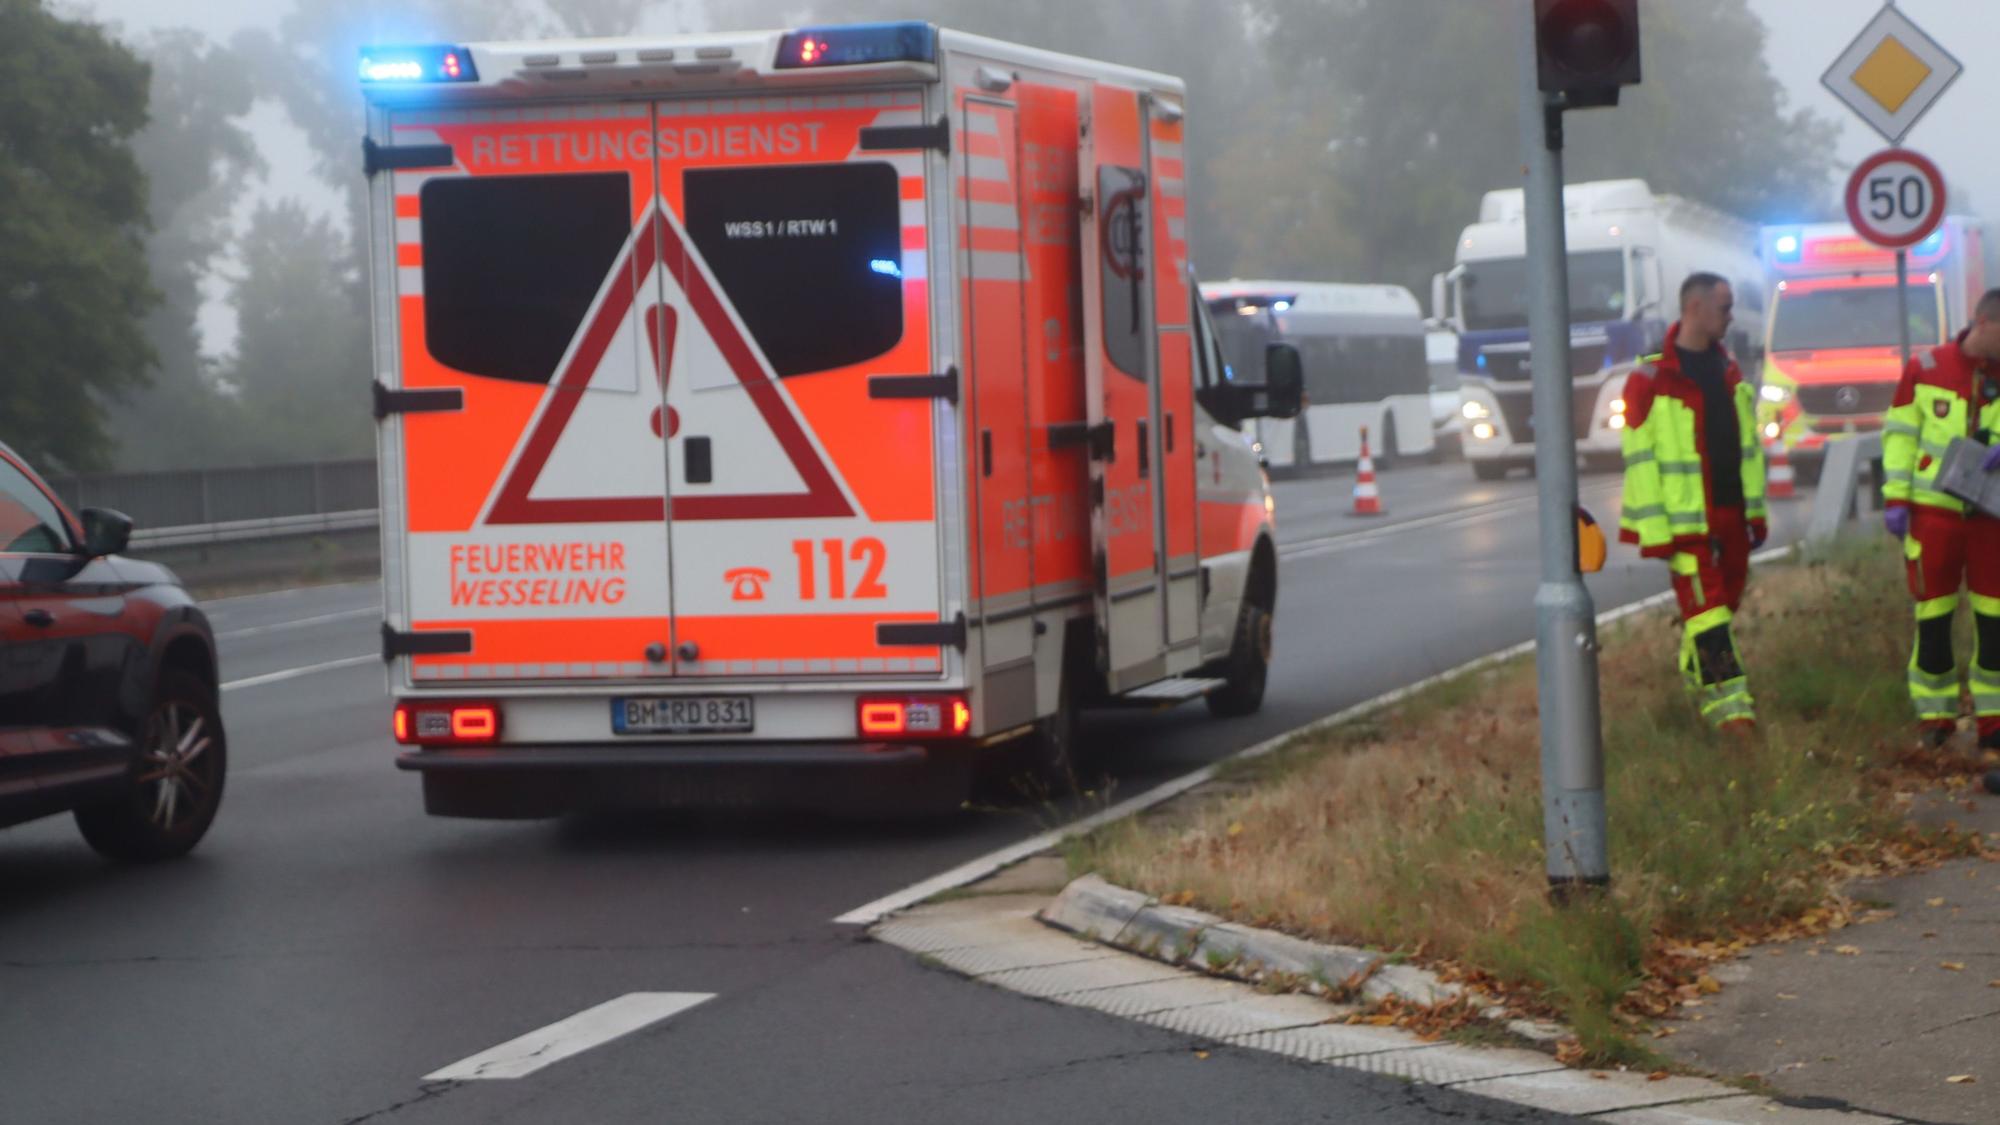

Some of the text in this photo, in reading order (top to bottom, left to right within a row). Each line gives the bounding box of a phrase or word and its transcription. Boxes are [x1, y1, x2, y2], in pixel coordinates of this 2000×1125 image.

[472, 123, 823, 165] RETTUNGSDIENST
[1869, 174, 1925, 221] 50
[777, 220, 784, 236] /
[450, 541, 626, 575] FEUERWEHR
[792, 536, 888, 601] 112
[450, 577, 626, 607] WESSELING
[627, 700, 748, 725] BM RD 831
